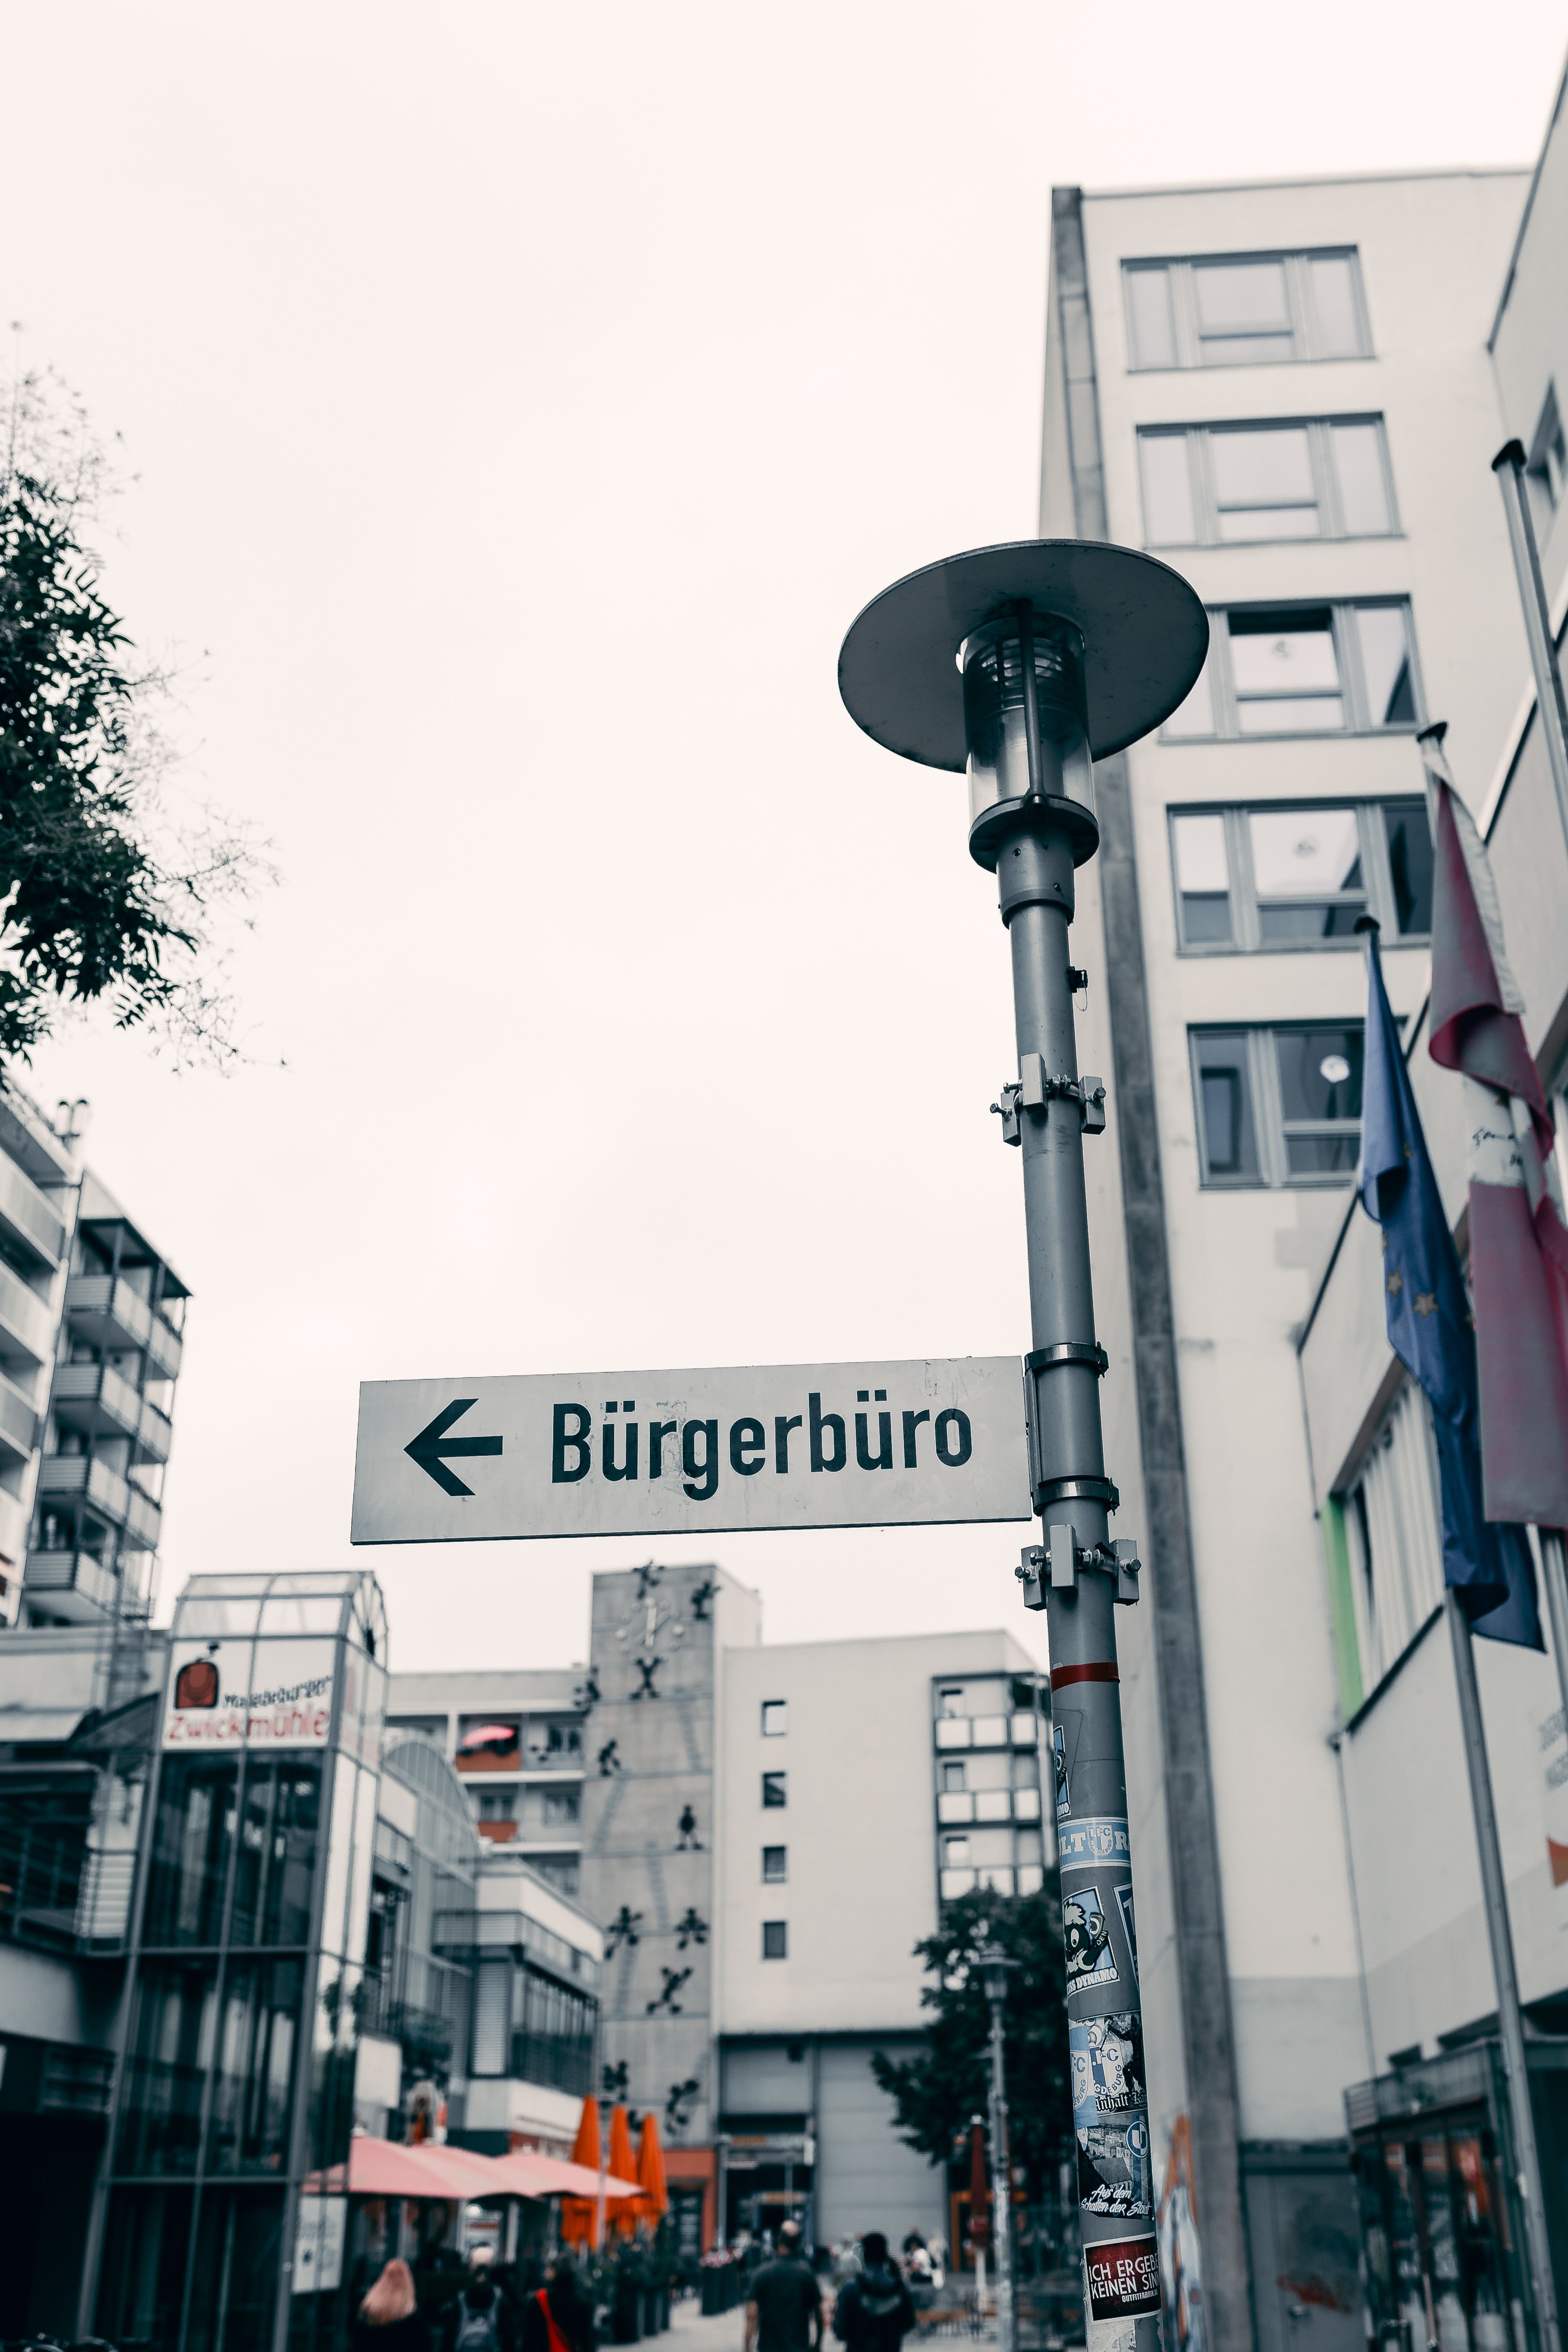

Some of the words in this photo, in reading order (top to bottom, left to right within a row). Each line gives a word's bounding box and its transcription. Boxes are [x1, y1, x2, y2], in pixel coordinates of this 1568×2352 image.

[552, 1390, 972, 1501] Bürgerbüro
[1077, 1967, 1117, 1988] DYNAMO
[1092, 2184, 1113, 2201] Aus
[1113, 2184, 1132, 2199] dem
[1080, 2196, 1109, 2213] Schatten
[1127, 2201, 1152, 2216] Stadt
[1089, 2262, 1112, 2282] ICH
[1091, 2276, 1137, 2300] KEINEN
[1122, 2289, 1158, 2303] OUTFITFABRIK.DE
